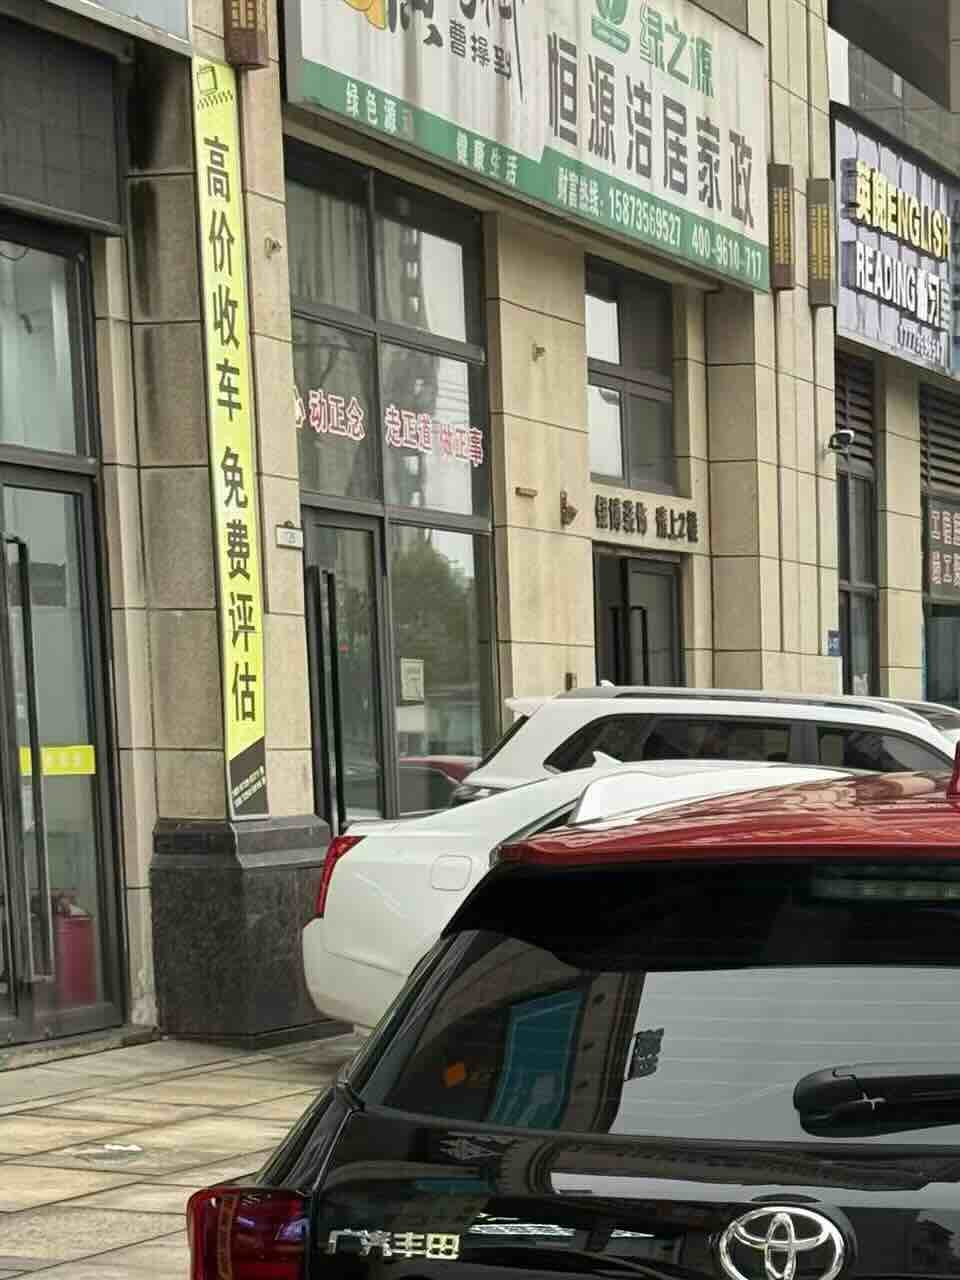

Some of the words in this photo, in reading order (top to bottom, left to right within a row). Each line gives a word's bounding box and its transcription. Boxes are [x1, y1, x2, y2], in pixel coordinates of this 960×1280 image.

[547, 31, 755, 230] 恒源洁居家政
[639, 0, 714, 98] 绿之源
[203, 134, 242, 422] 高价收车
[219, 445, 257, 722] 免费评估
[327, 1228, 461, 1260] 广汽丰田
